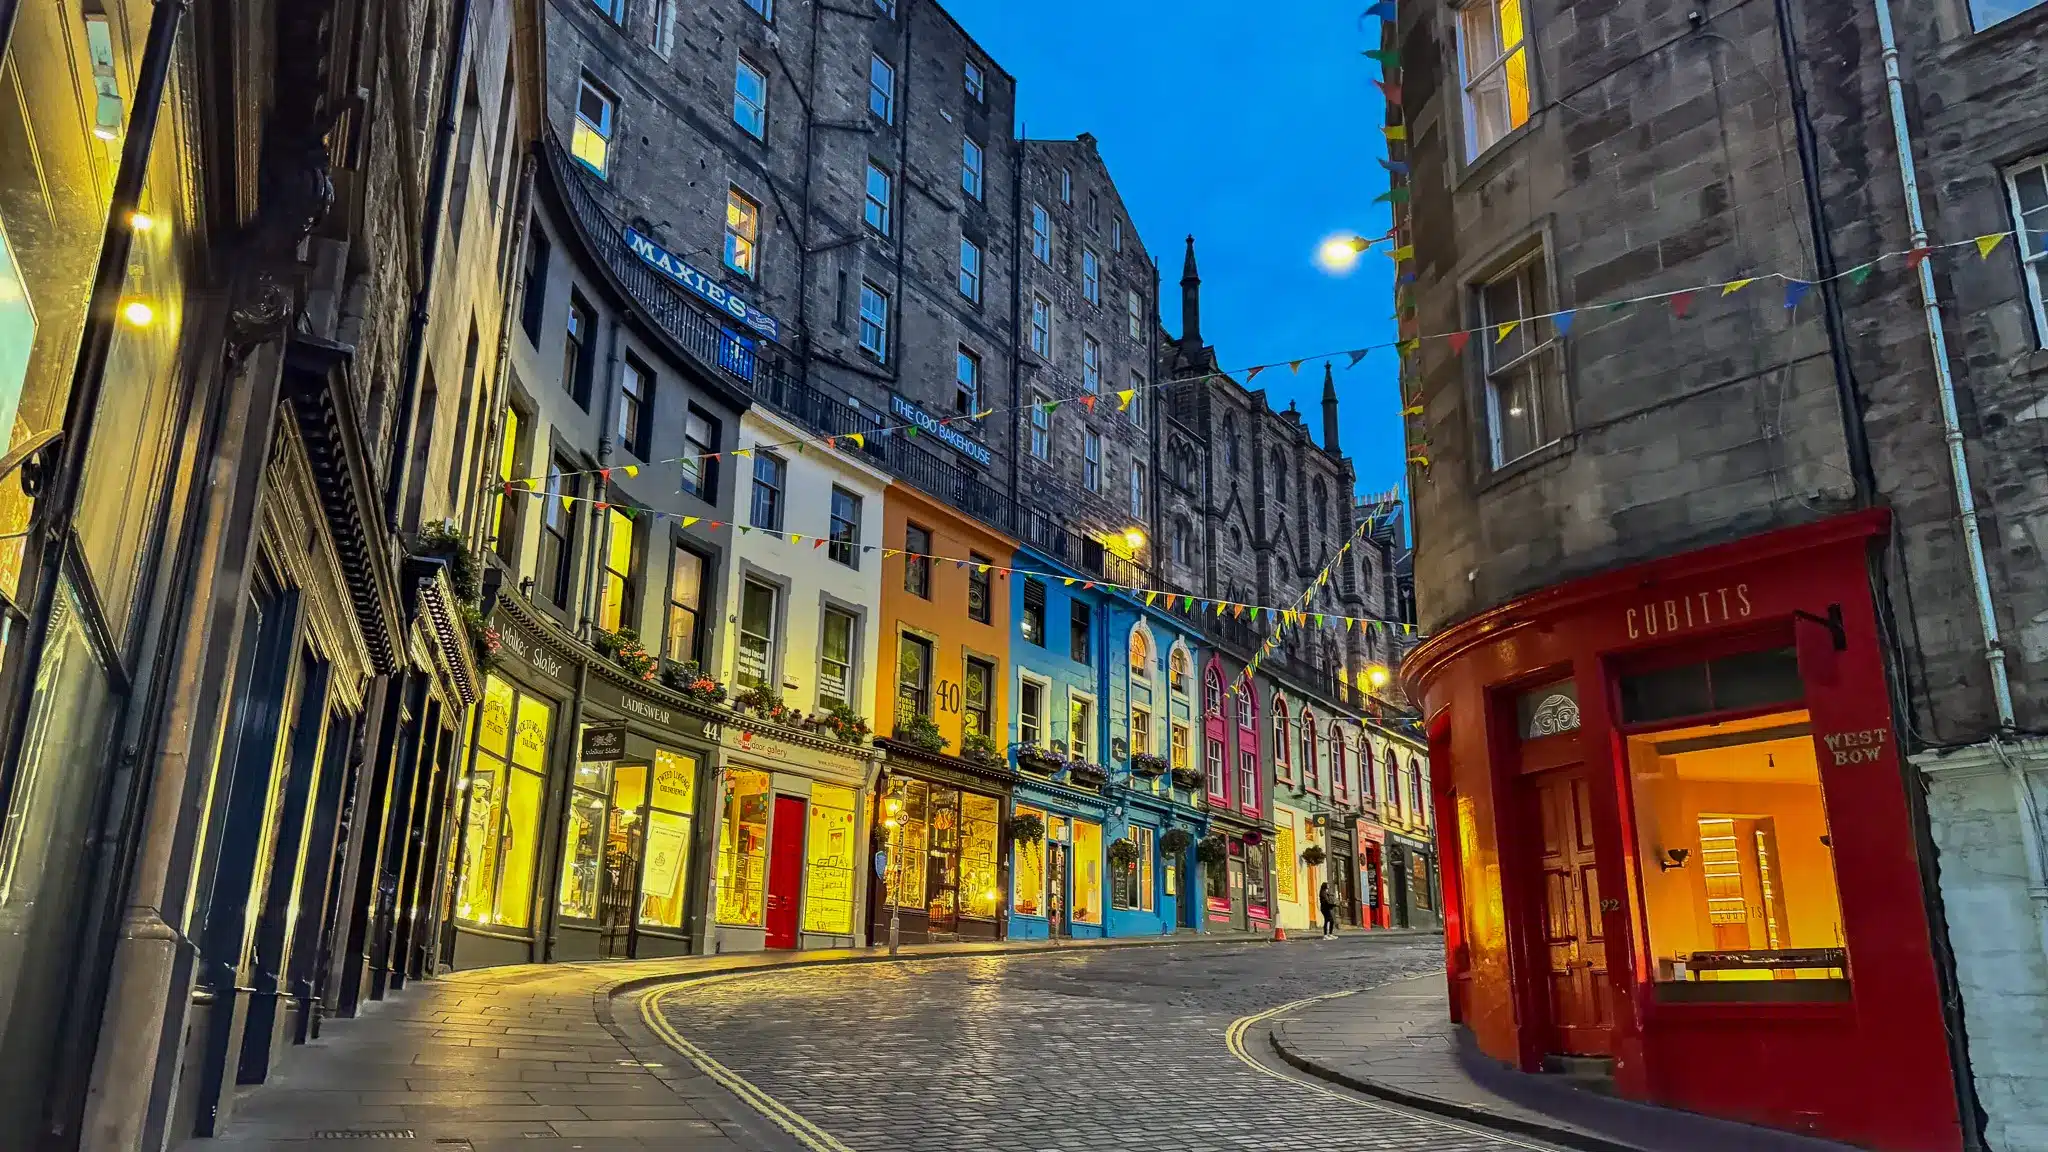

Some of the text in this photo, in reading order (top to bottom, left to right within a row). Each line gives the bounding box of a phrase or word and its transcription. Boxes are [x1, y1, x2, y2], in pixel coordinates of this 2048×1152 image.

[630, 234, 746, 318] MAXIES
[893, 396, 914, 421] THE
[939, 425, 991, 466] BAKEHOUSE
[1626, 583, 1751, 639] CUBITTS
[501, 623, 529, 658] Walker
[533, 648, 561, 678] Slater
[621, 695, 670, 725] LADIESWEAR
[936, 679, 960, 715] 40
[751, 740, 766, 751] door
[766, 744, 788, 759] gallery
[1823, 728, 1887, 751] WEST
[1832, 745, 1881, 766] BOW
[1600, 898, 1620, 912] 92
